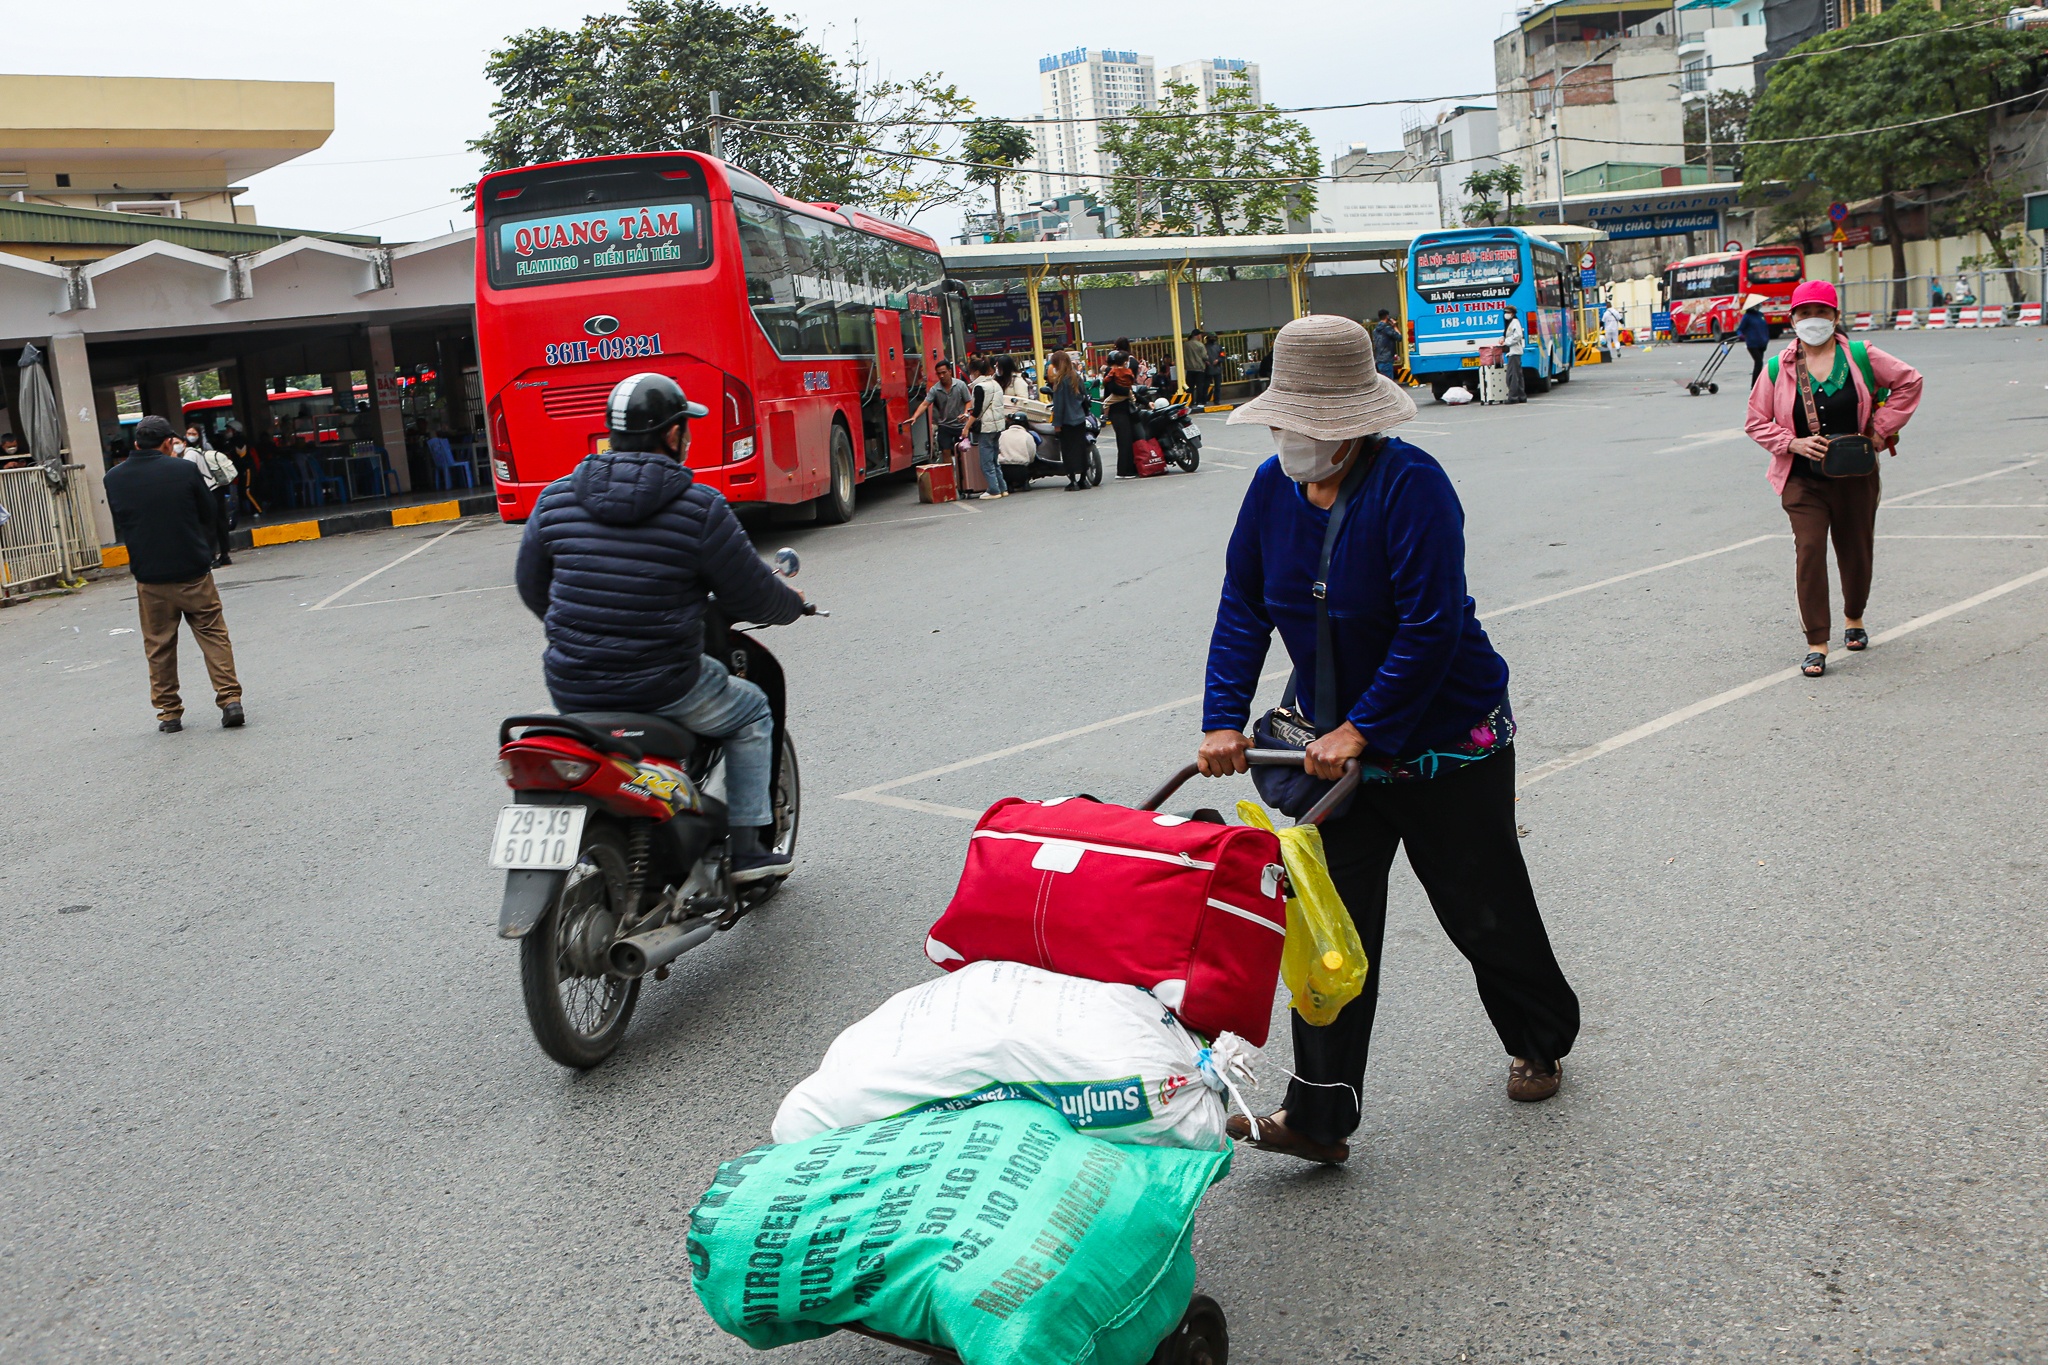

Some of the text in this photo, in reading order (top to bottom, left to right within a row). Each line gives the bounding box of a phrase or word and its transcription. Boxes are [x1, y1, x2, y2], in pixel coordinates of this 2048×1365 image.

[1039, 46, 1087, 74] HÒA PHÁT
[1630, 203, 1652, 213] XE
[514, 207, 681, 257] QUANG TÂM
[516, 254, 579, 276] FLAMINGO
[594, 244, 624, 267] BIỂN
[626, 243, 649, 263] HẢI
[652, 240, 681, 261] TIẾN
[1429, 253, 1443, 268] NỘI
[1431, 291, 1455, 301] HÀ NỘI
[1435, 300, 1506, 315] HẢI THỊNH
[545, 332, 664, 366] 36H-09321
[509, 810, 571, 836] 29-X9
[503, 838, 566, 864] 6010
[1060, 1085, 1140, 1126] Sunjin
[957, 1119, 1004, 1161] NET
[896, 1141, 945, 1180] 0.5
[935, 1167, 980, 1200] KG
[937, 1121, 1061, 1274] USE NO HOOKS
[741, 1193, 808, 1328] NITROGEN
[785, 1144, 842, 1187] 46.0
[915, 1206, 958, 1235] 50
[798, 1214, 852, 1313] BIURET
[830, 1164, 878, 1205] 1.0
[970, 1255, 1057, 1321] MADE
[1030, 1229, 1075, 1267] IN
